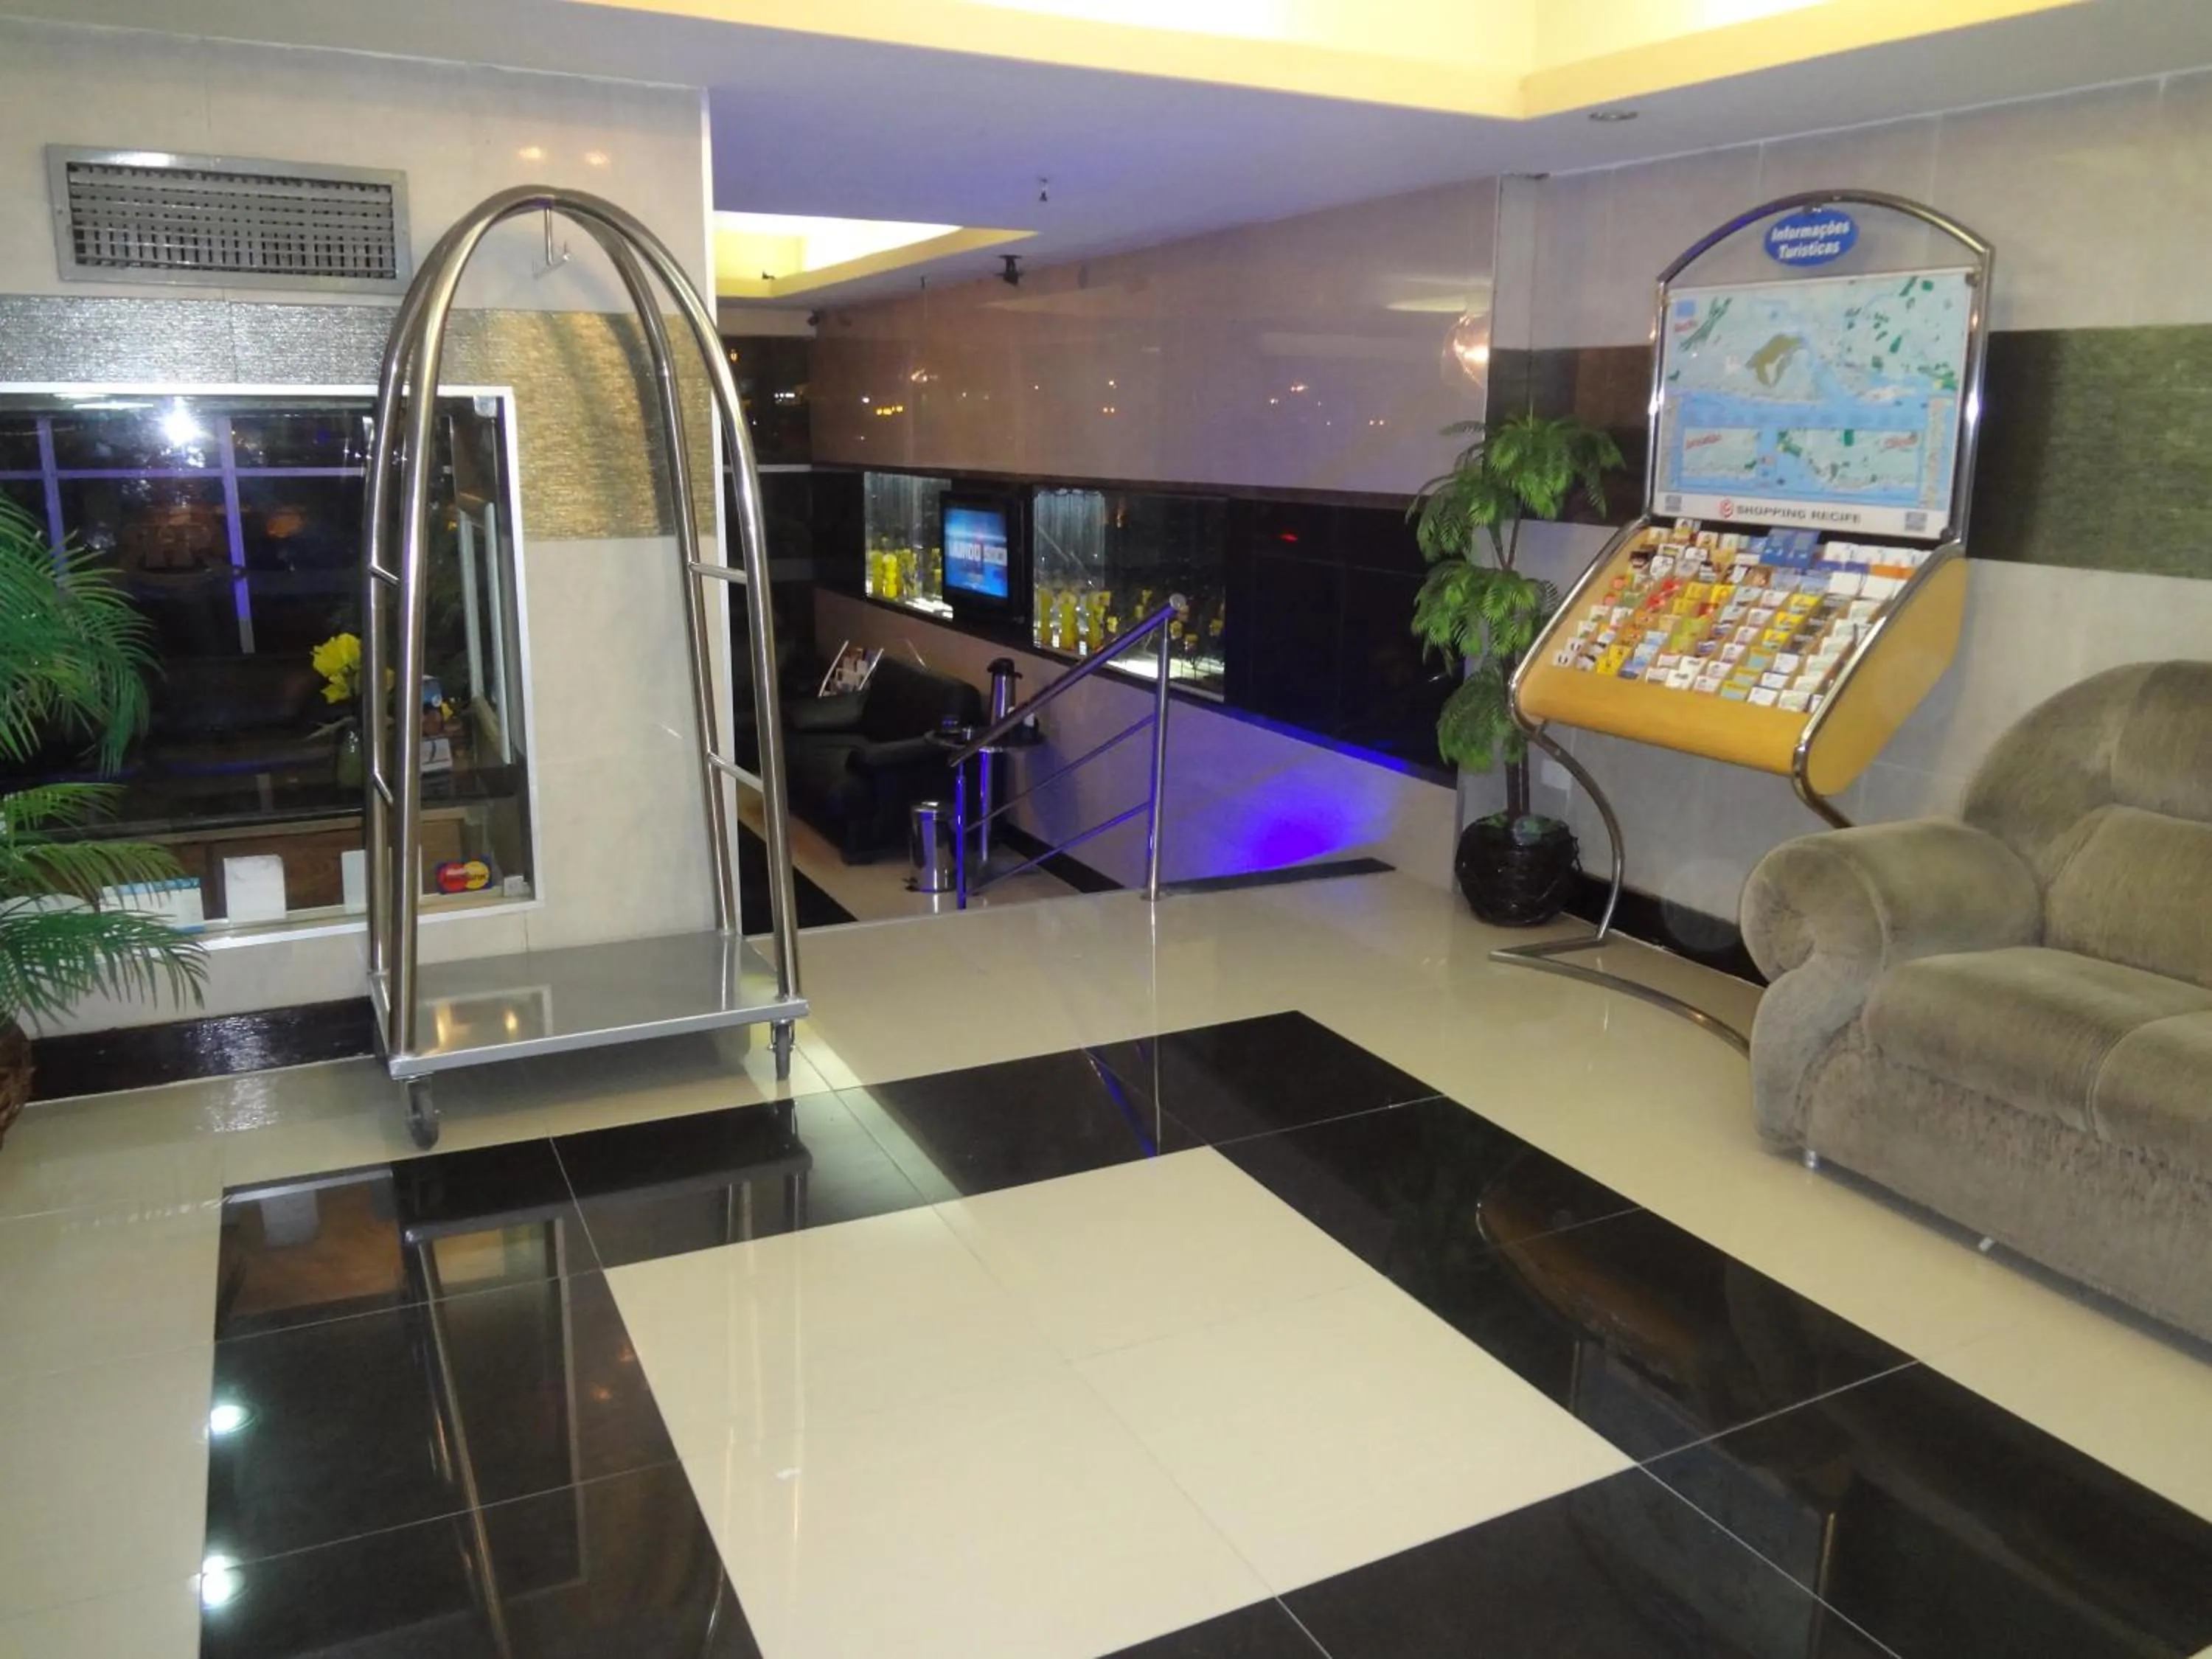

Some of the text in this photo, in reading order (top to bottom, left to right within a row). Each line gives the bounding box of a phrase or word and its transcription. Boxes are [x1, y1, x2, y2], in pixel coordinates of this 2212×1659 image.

[1771, 220, 1850, 242] Informações
[1736, 505, 1862, 524] SHOPPING RECIFE
